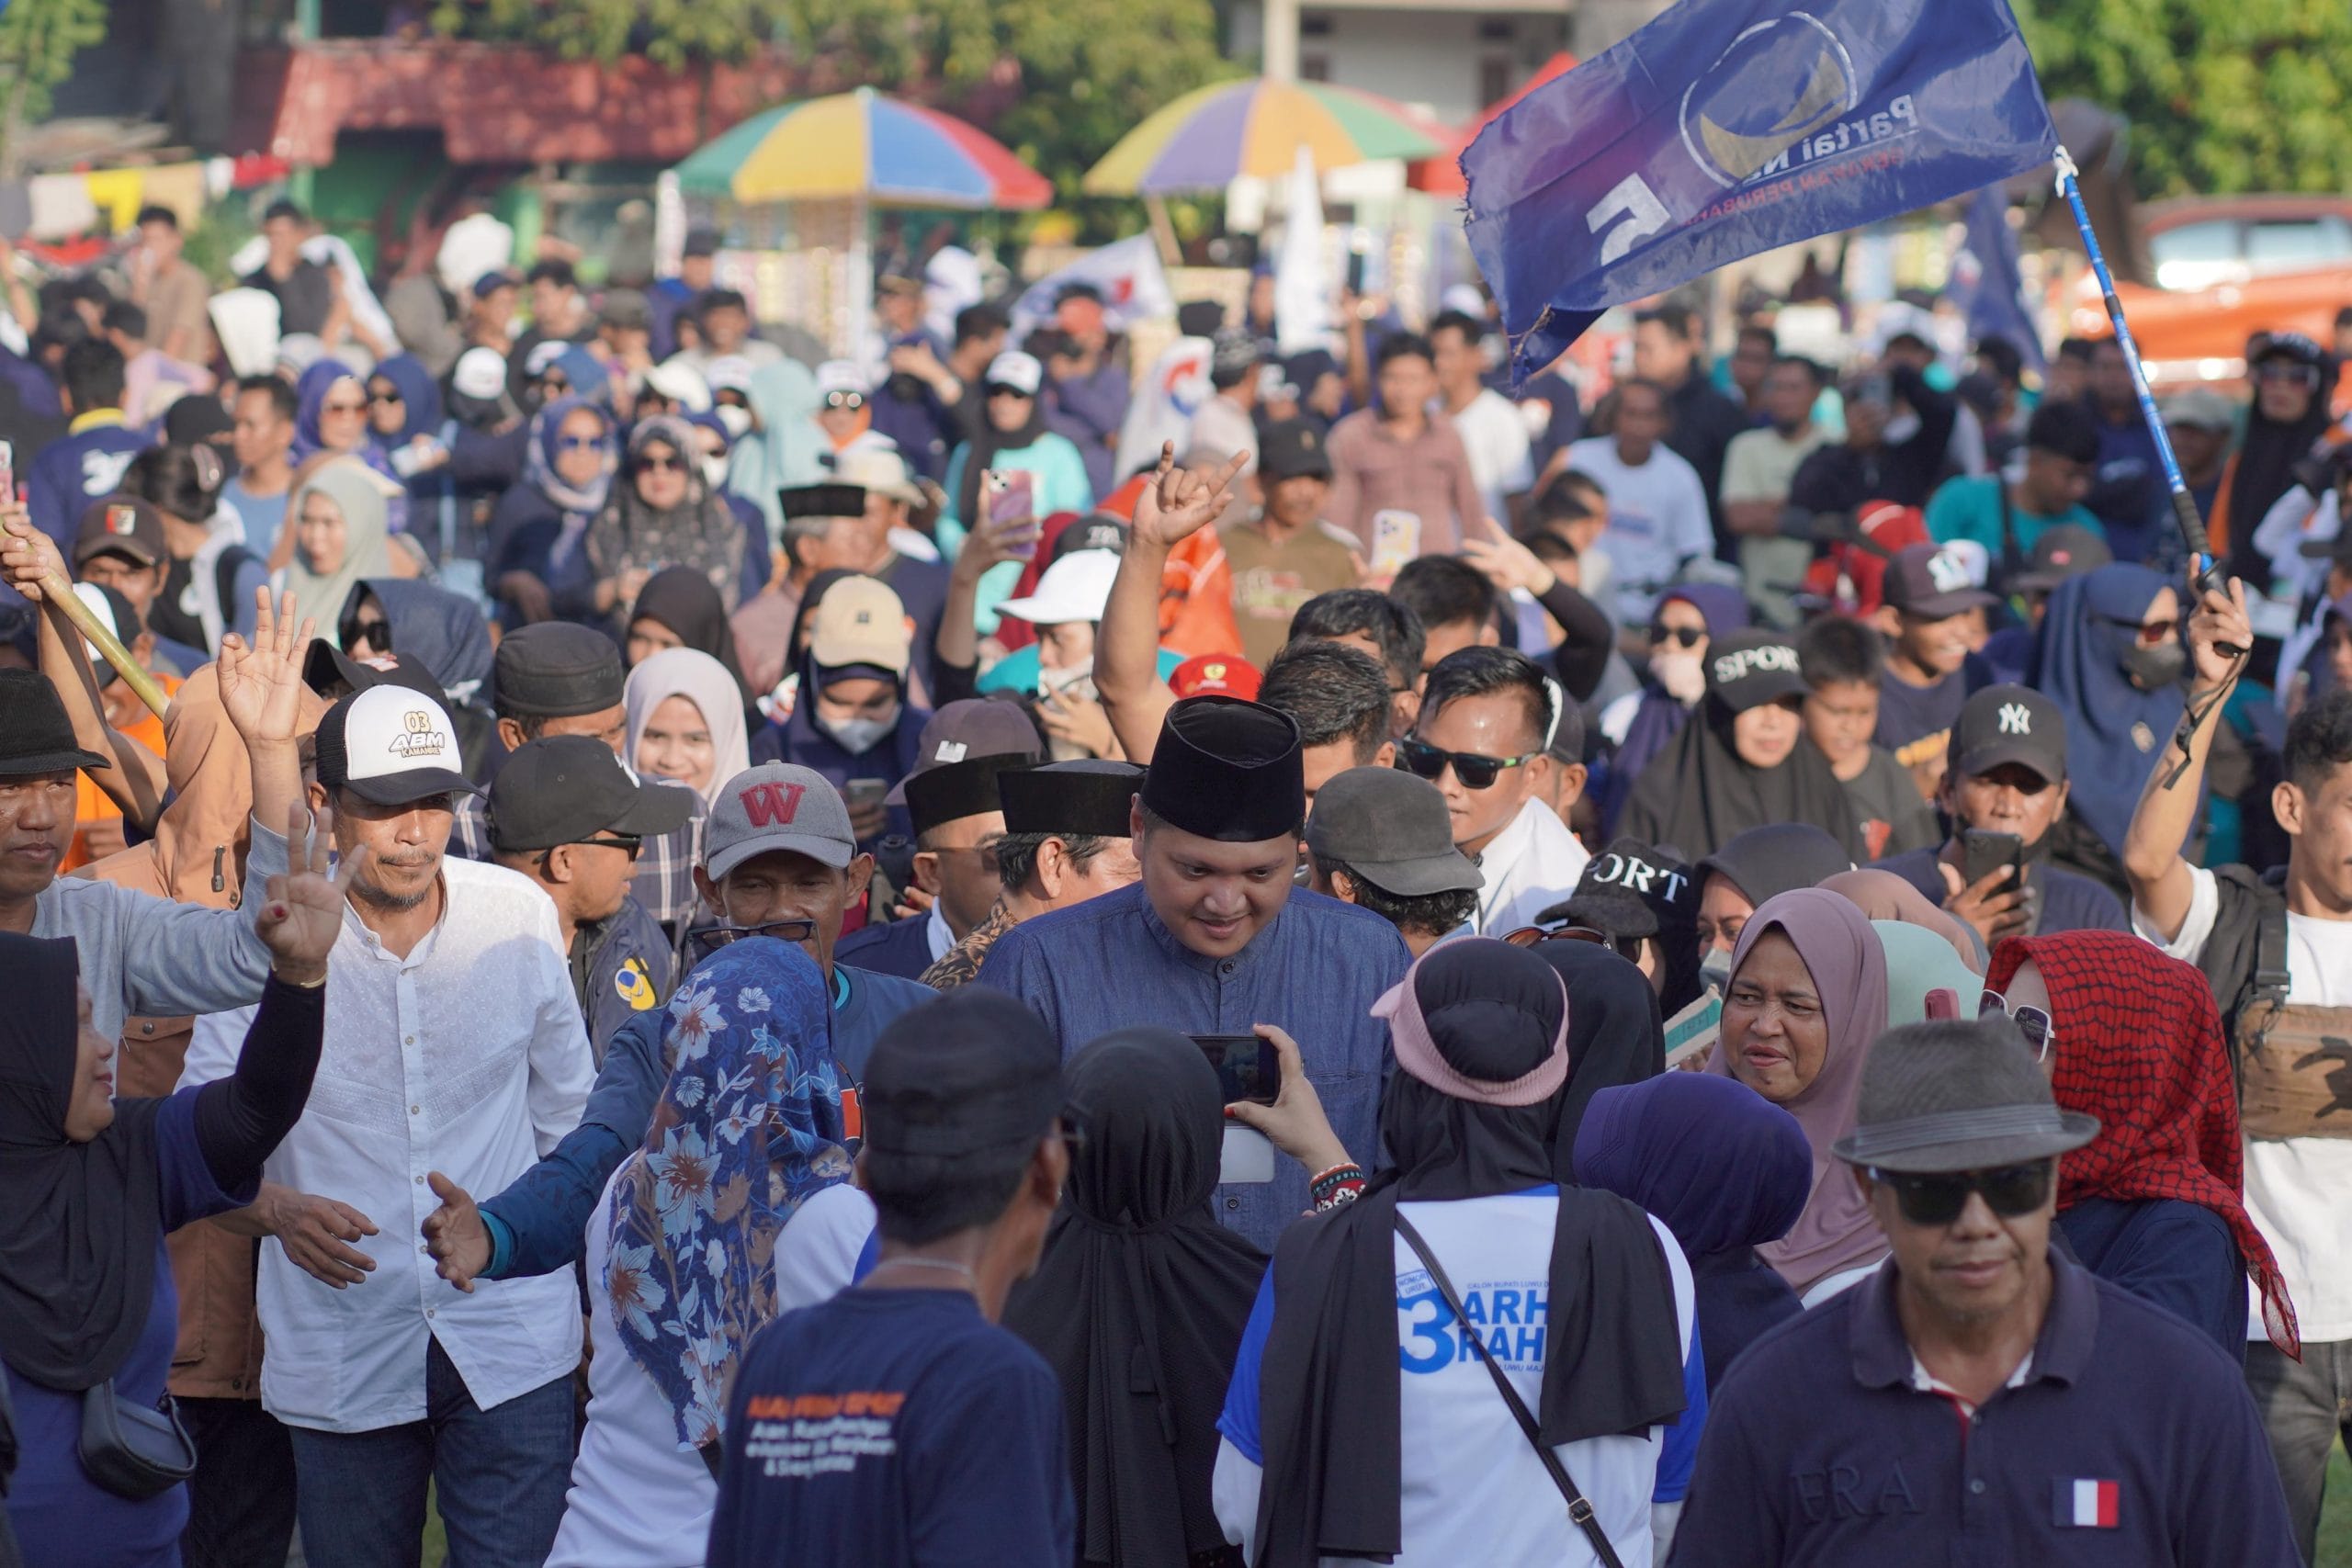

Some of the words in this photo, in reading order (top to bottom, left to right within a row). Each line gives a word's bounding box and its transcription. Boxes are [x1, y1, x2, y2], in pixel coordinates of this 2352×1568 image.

[1714, 645, 1801, 682] SPOR
[404, 711, 432, 734] 03
[1998, 702, 2031, 735] NY
[389, 732, 445, 753] ABM
[739, 781, 808, 829] W
[1587, 852, 1689, 903] ORT
[1397, 1271, 1427, 1288] NOMOR
[1458, 1290, 1548, 1325] ARH
[1396, 1288, 1457, 1374] 3
[1458, 1326, 1545, 1361] RAH
[1525, 1364, 1544, 1372] MAJ
[1790, 1456, 1927, 1526] FRA
